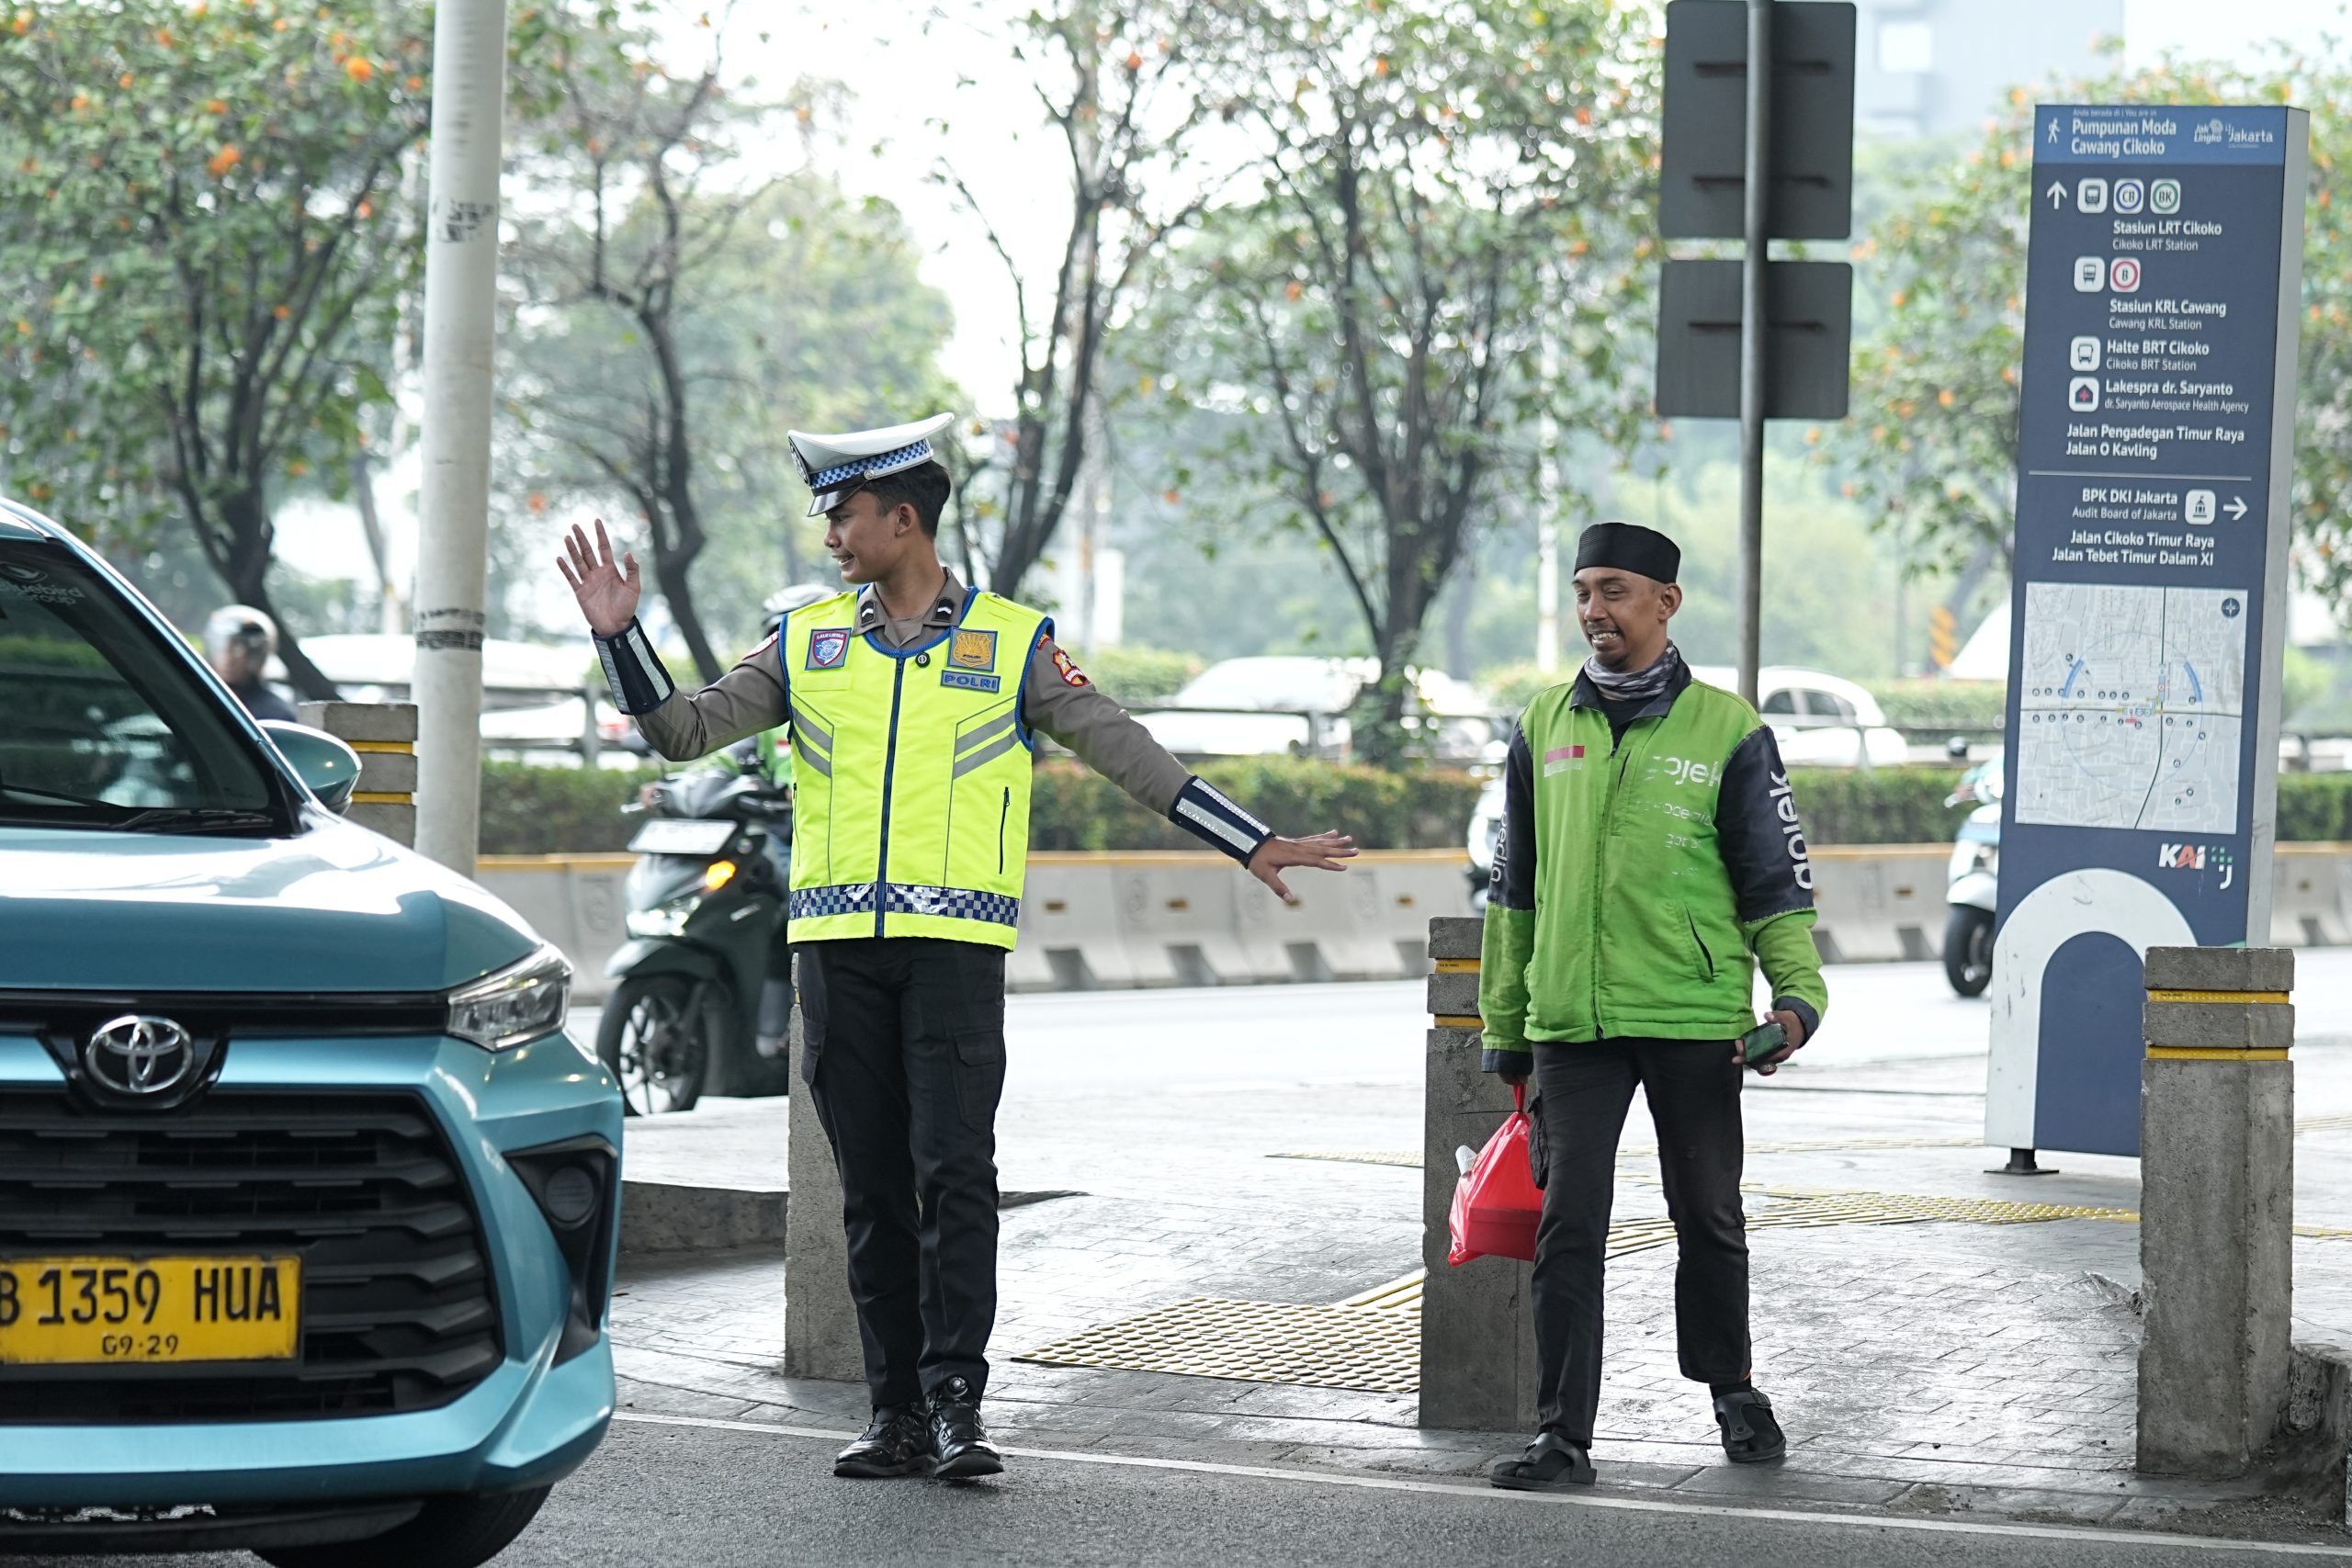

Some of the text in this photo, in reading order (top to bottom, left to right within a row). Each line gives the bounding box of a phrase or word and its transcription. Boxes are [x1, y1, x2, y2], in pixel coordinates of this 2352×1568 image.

[2125, 108, 2137, 117] You
[2151, 108, 2157, 117] in
[2072, 118, 2177, 139] Pumpunan Moda
[2228, 128, 2274, 142] Jakarta
[2071, 138, 2165, 158] Cawang Cikoko
[2122, 191, 2135, 202] CB
[2113, 220, 2222, 236] Stasiun LRT Cikoko
[2112, 238, 2199, 251] Cikoko LRT Station
[2109, 299, 2226, 317] Stasiun KRL Cawang
[2109, 317, 2202, 331] Cawang KRL Station
[2107, 340, 2210, 355] Halte BRT Cikoko
[2107, 357, 2197, 371] Cikoko BRT Station
[2106, 379, 2233, 398] Lakespra dr. Saryanto
[2105, 398, 2249, 414] dr. Saryanto Aerospace Health Agency
[2067, 423, 2245, 443] Jalan Pengadegan Timur Raya
[2066, 442, 2157, 459] Jalan O Kavling
[2082, 488, 2177, 504] BPK DKI Jakarta
[2072, 506, 2177, 521] Audit Board of Jakarta
[2071, 530, 2214, 548] Jalan Cikoko Timur Raya
[2052, 547, 2213, 566] Jalan Tebet Timur Dalam XI
[944, 674, 997, 688] POLRI
[2158, 843, 2206, 869] KAI
[0, 1266, 281, 1326] B 1359 HUA
